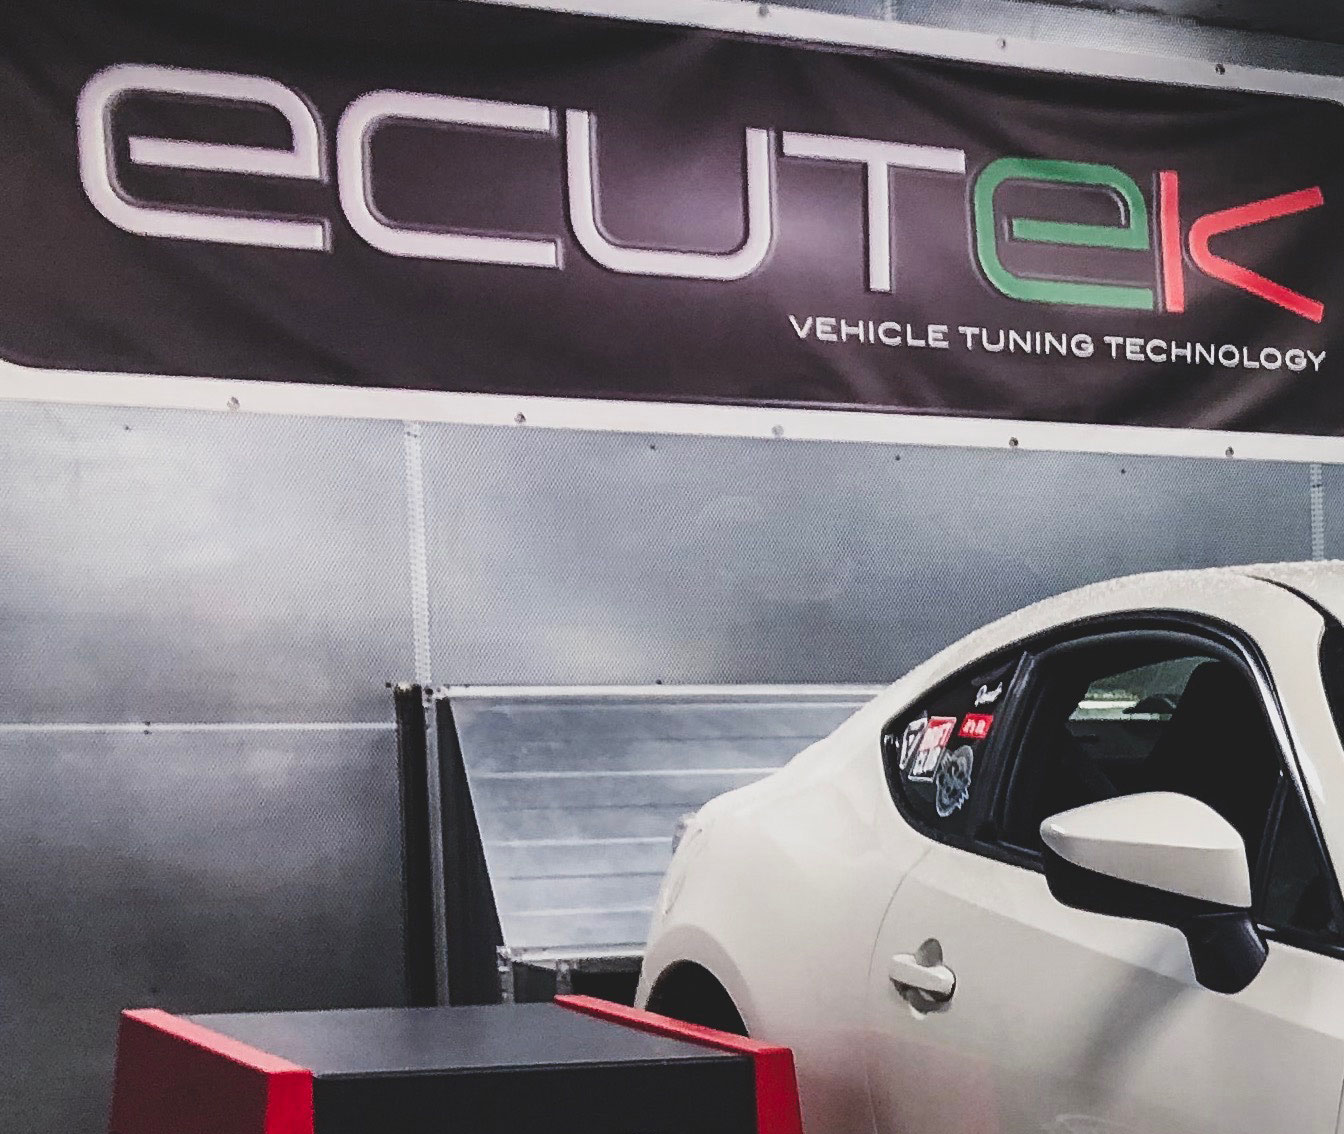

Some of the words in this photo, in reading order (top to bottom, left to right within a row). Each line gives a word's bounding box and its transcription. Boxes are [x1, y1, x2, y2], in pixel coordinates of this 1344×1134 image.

[788, 314, 949, 349] VEHICLE
[958, 325, 1094, 358] TUNING
[1103, 334, 1327, 372] TECHNOLOGY
